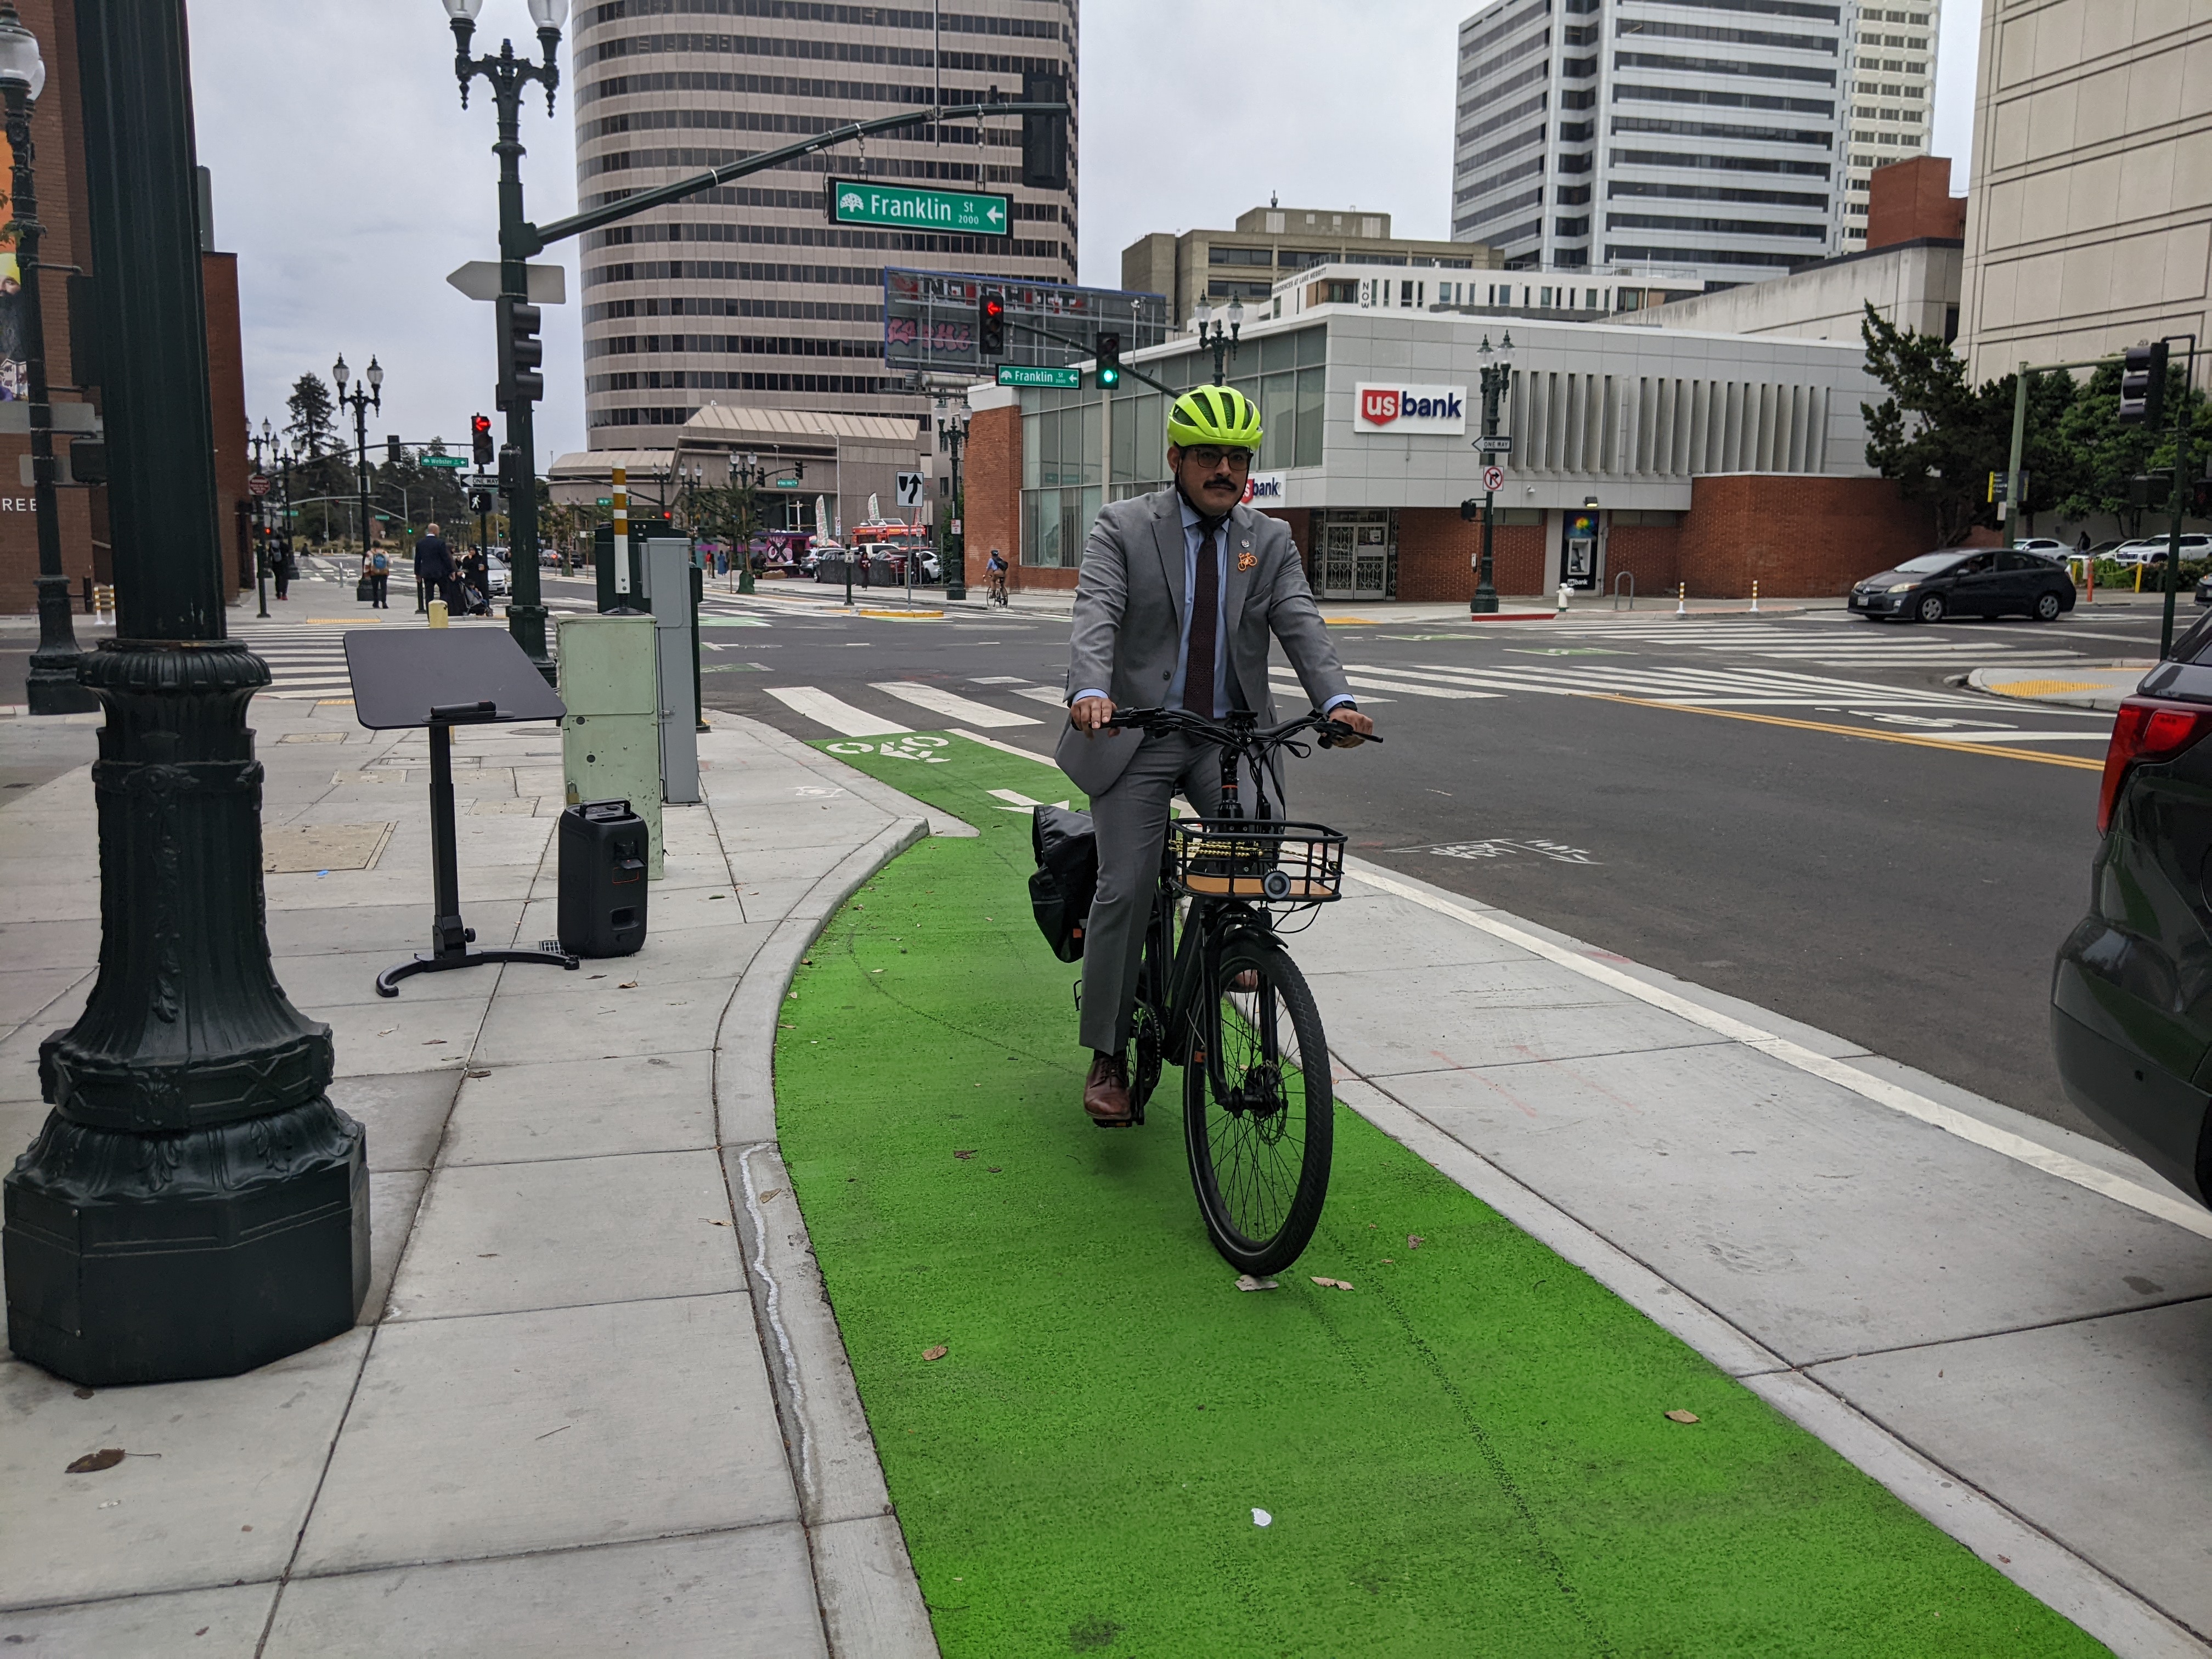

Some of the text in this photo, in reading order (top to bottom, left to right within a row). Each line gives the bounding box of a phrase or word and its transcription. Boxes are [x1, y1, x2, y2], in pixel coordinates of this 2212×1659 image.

[871, 194, 973, 221] Franklin St
[958, 214, 979, 224] 2000
[1294, 278, 1299, 286] AT
[1300, 273, 1309, 284] LAKE
[1310, 267, 1327, 279] MERRITT
[1015, 370, 1053, 382] Franklin
[1402, 391, 1463, 418] bank
[1252, 477, 1280, 496] bank
